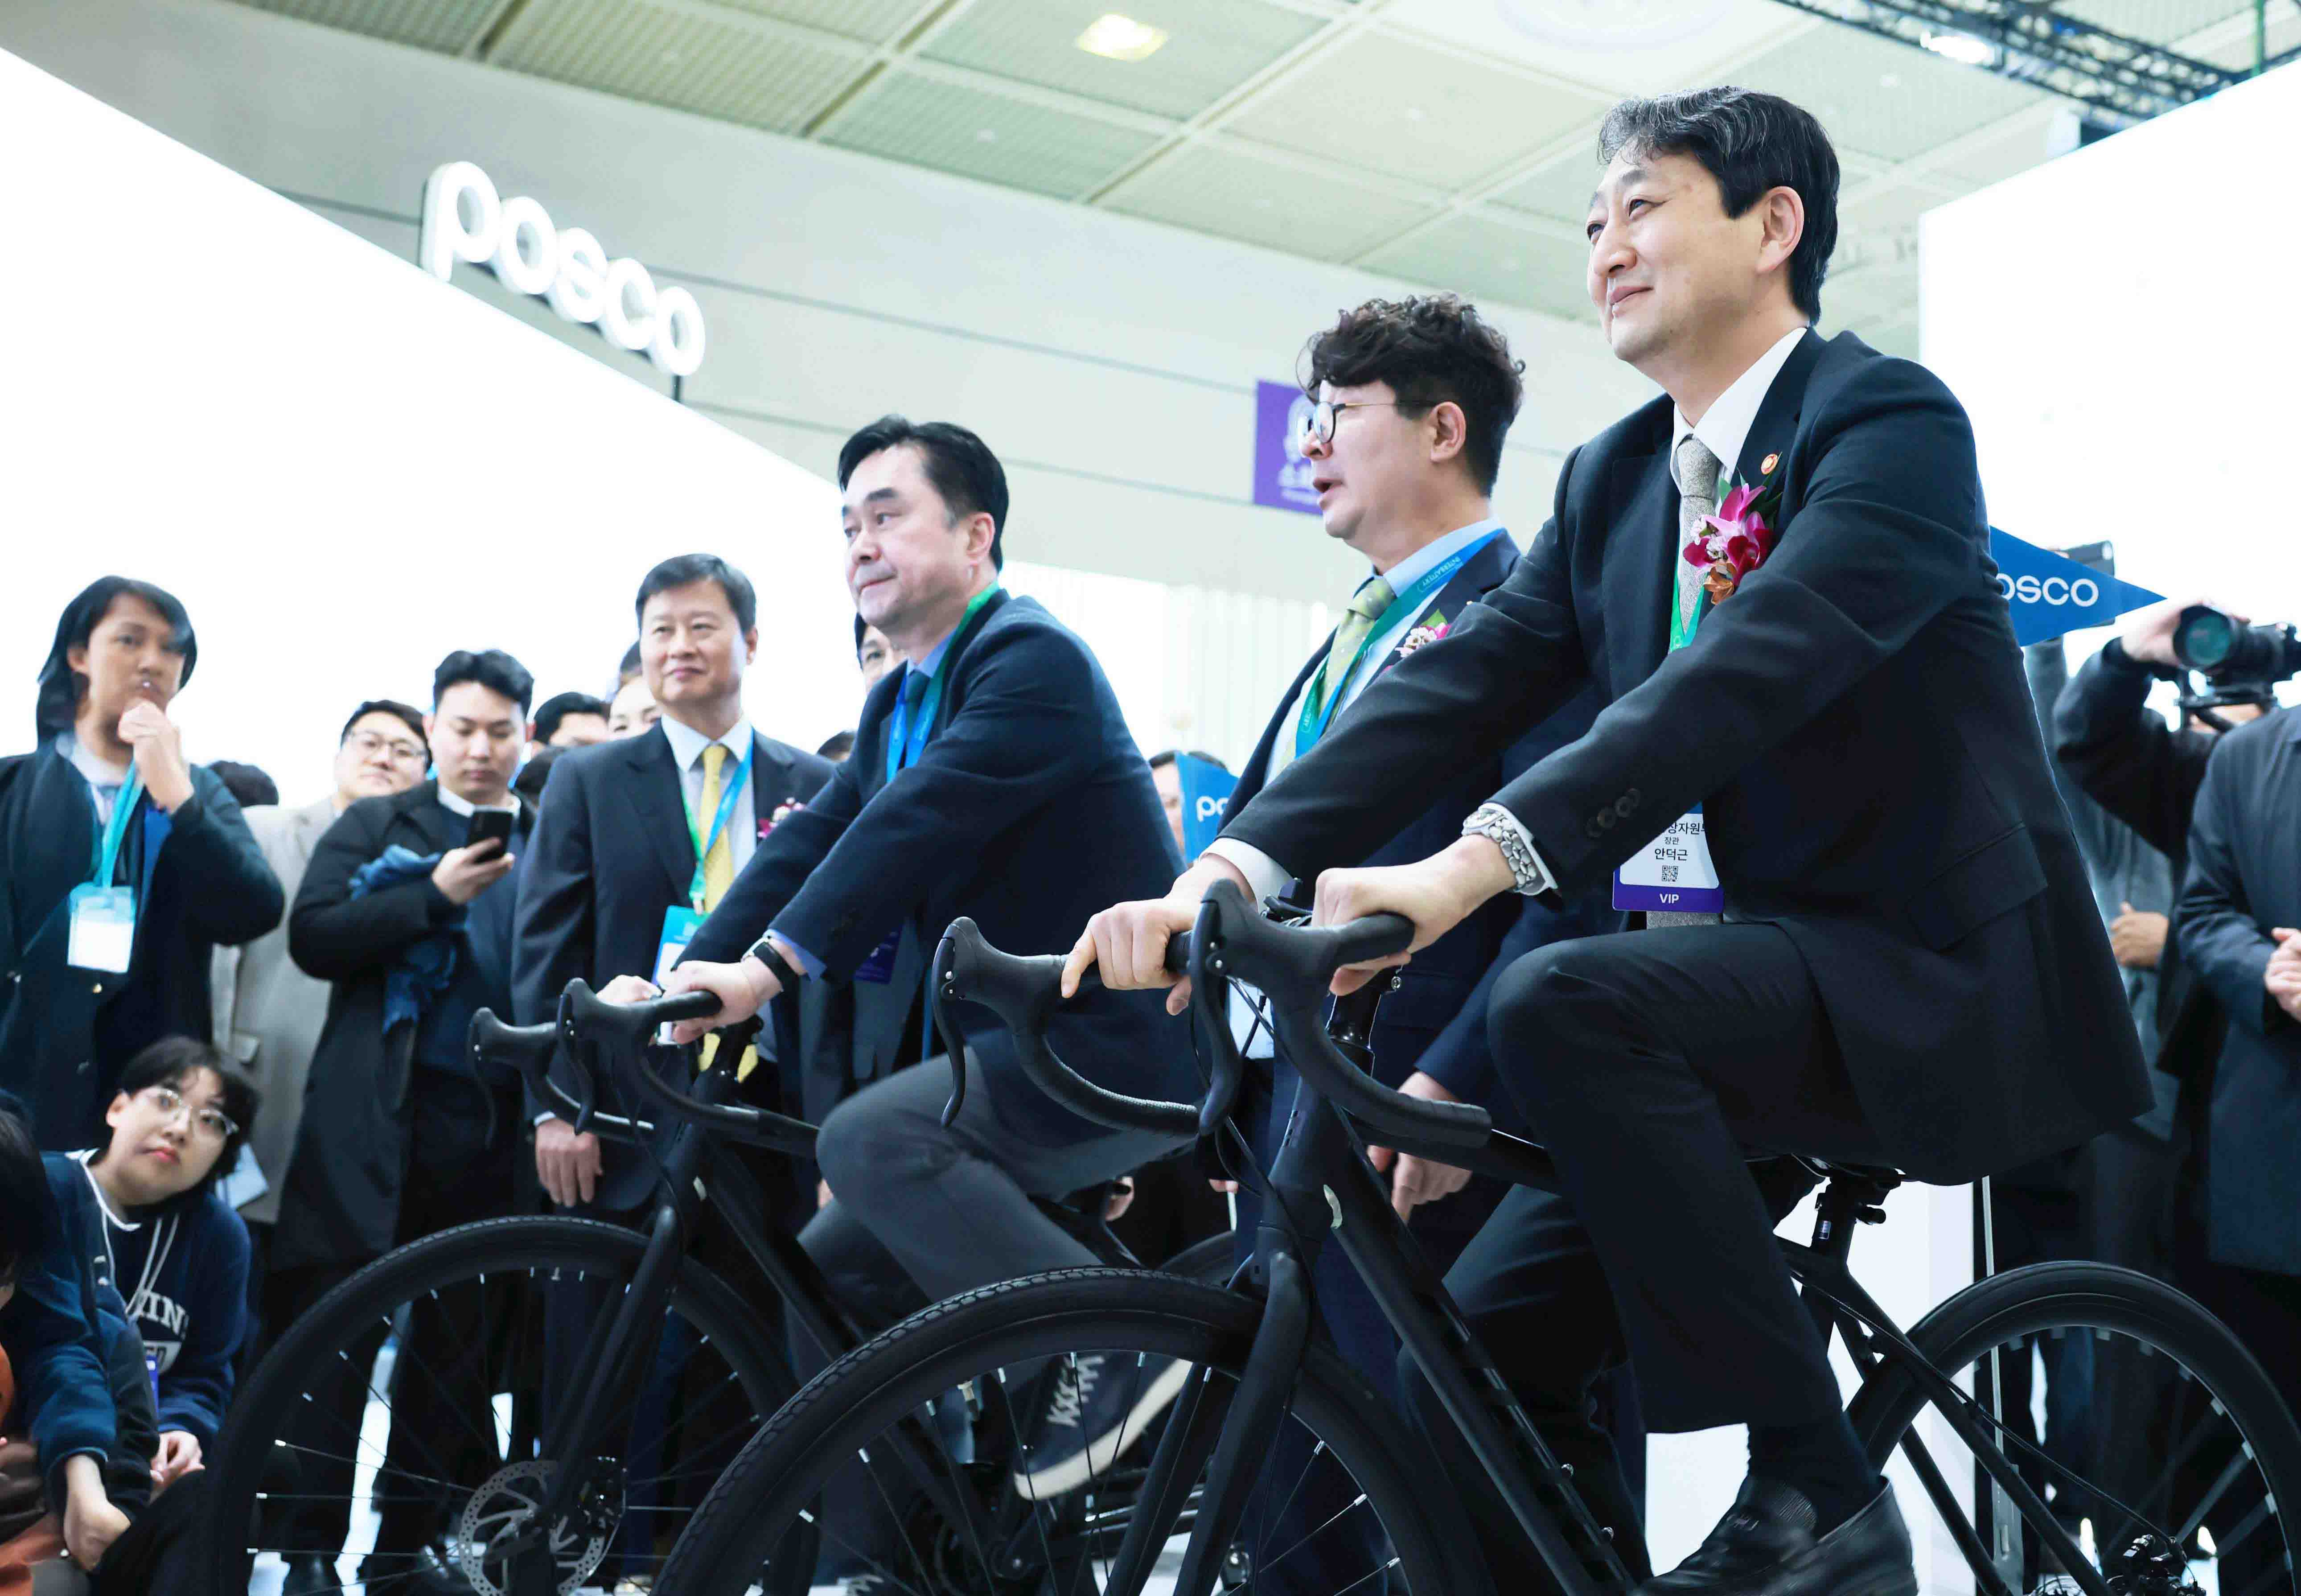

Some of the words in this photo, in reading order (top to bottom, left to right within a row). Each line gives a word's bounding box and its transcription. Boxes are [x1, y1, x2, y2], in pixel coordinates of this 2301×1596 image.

[421, 161, 706, 375] posco
[1664, 836, 1679, 845] 장관
[1655, 847, 1688, 861] 안덕근
[1660, 893, 1679, 904] VIP
